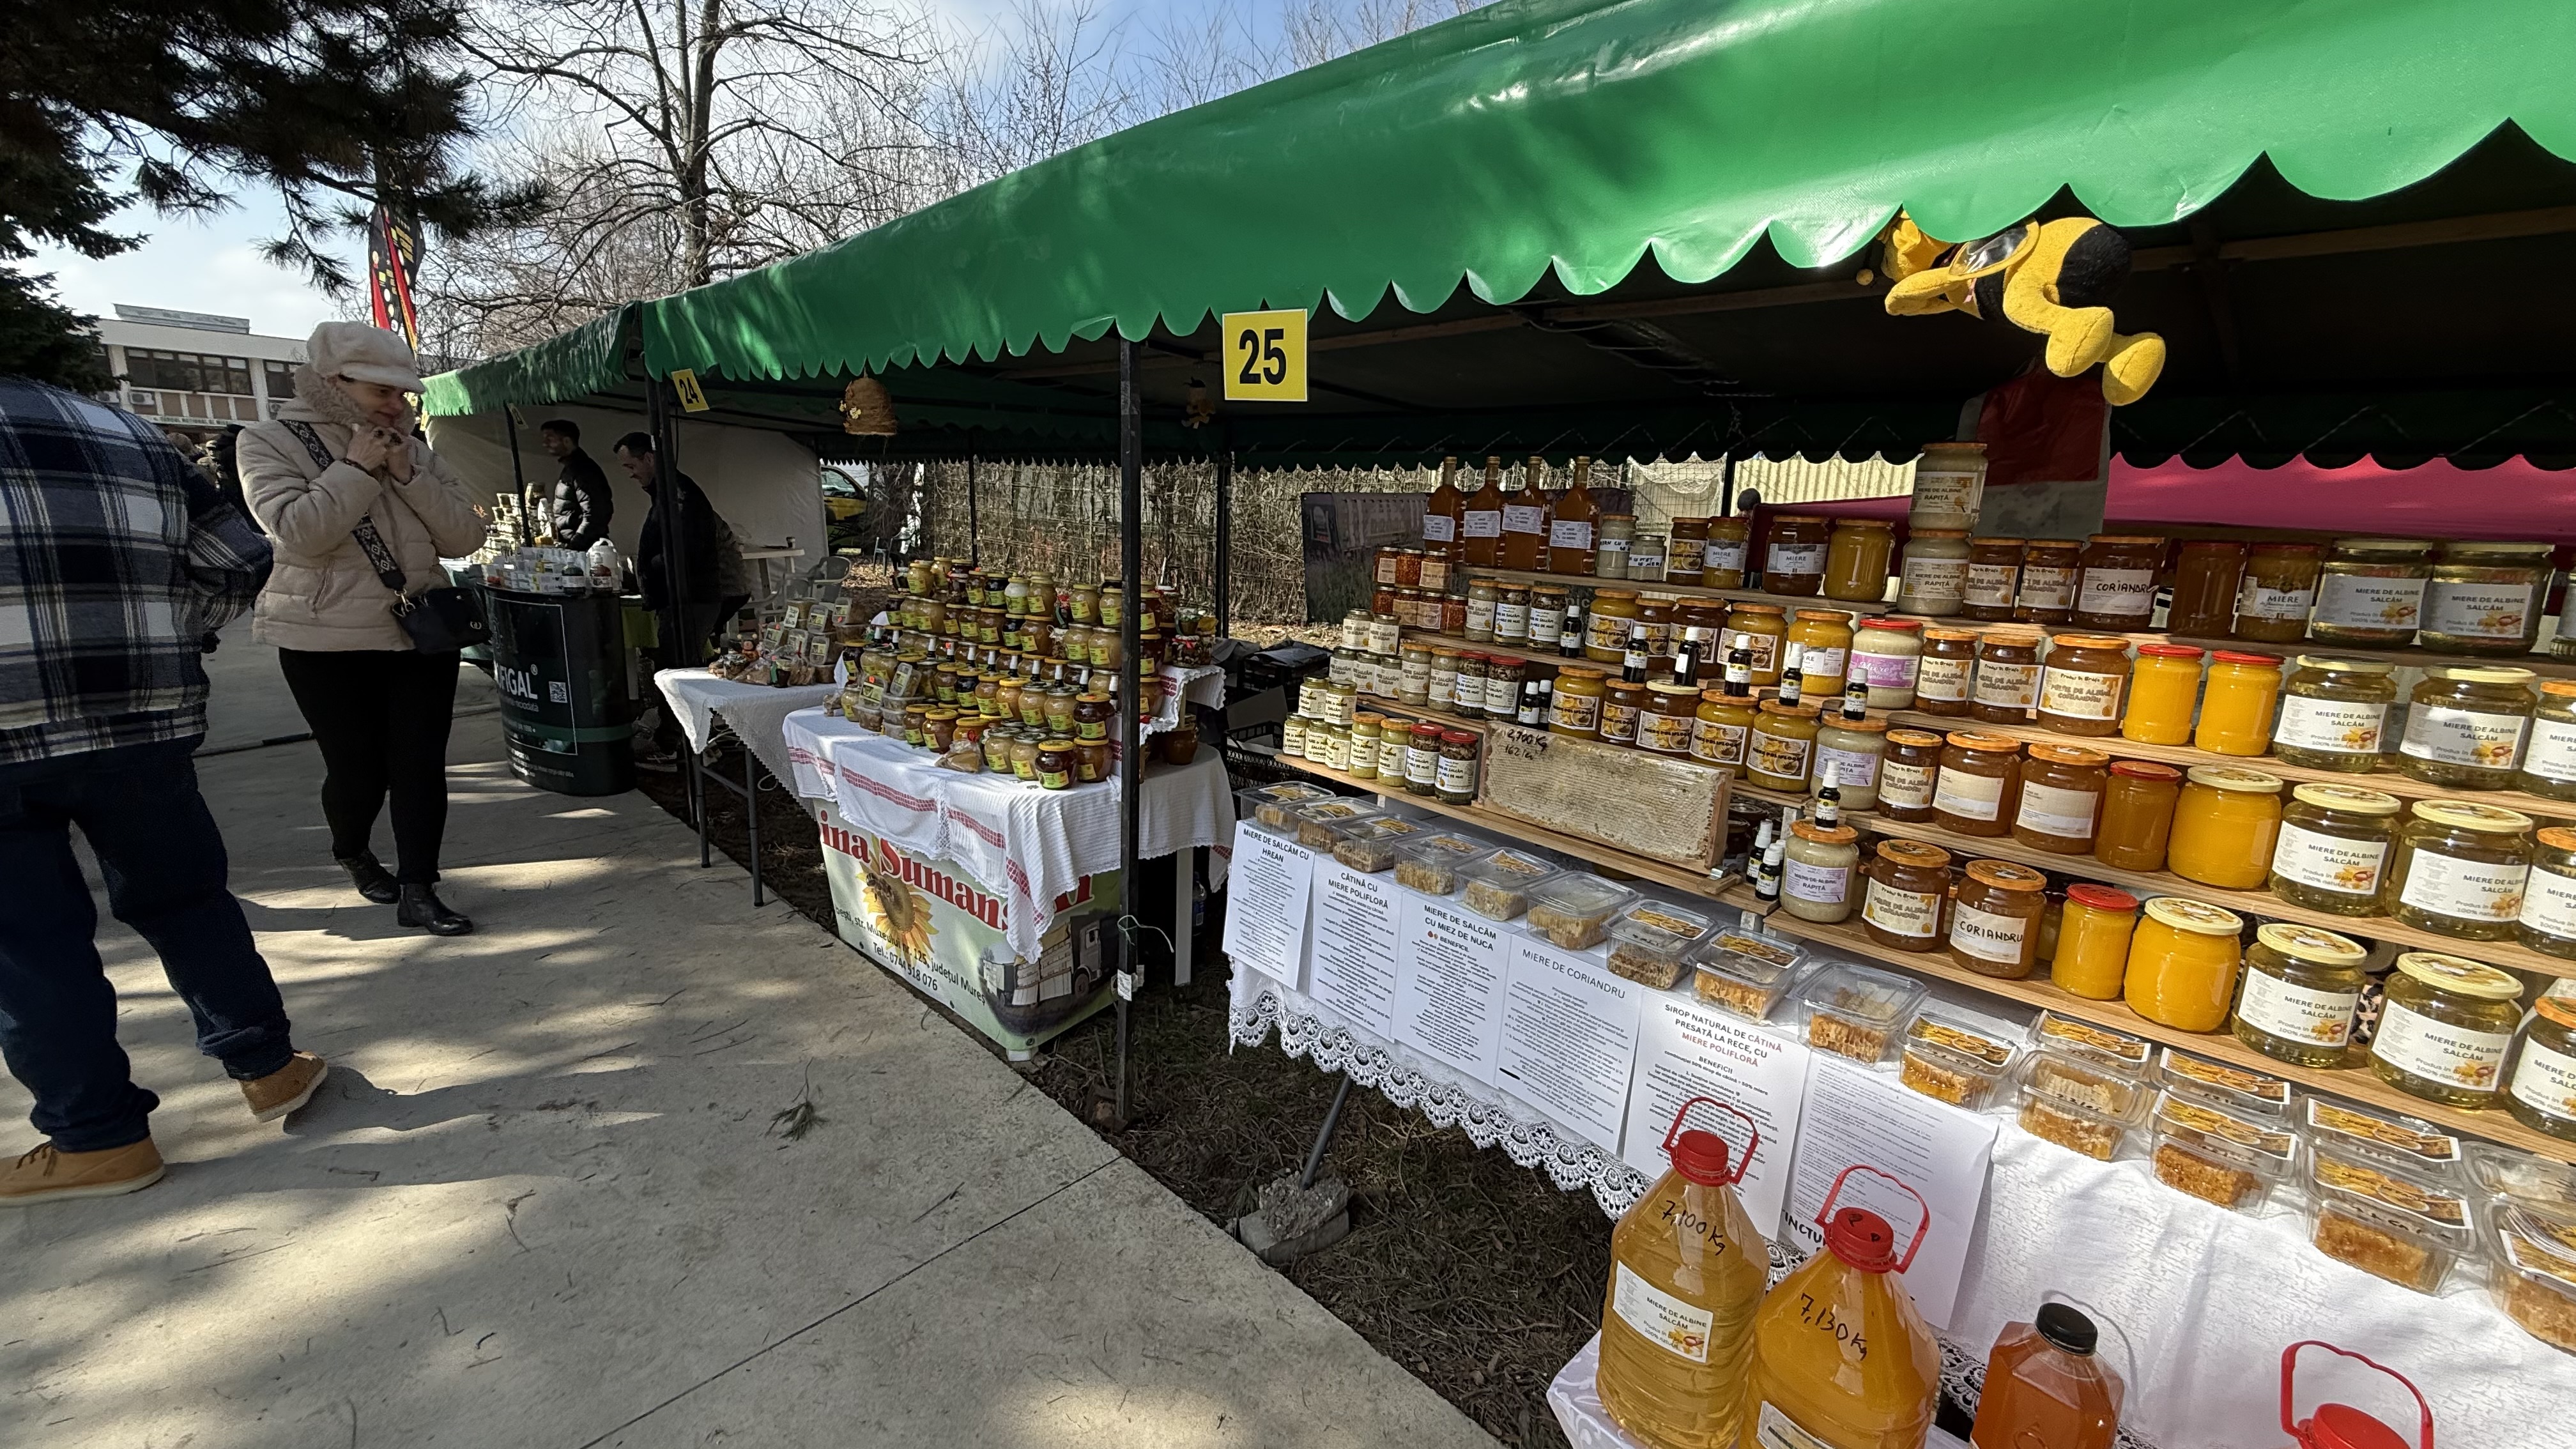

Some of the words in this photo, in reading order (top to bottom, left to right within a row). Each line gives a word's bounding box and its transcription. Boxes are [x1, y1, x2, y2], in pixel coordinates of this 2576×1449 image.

[1239, 328, 1287, 385] 25
[679, 377, 700, 404] 24
[2443, 721, 2471, 731] MIERE
[2436, 746, 2460, 755] Produs
[2542, 760, 2567, 768] Produs
[1244, 828, 1262, 843] MIERE
[1263, 835, 1271, 846] DE
[1300, 849, 1310, 860] CU
[2308, 844, 2334, 854] MIERE
[1262, 847, 1284, 862] HREAN
[2302, 868, 2324, 877] Produs
[2464, 875, 2493, 884] MIERE
[1328, 878, 1349, 895] MIERE
[1350, 887, 1388, 909] POLIFLORĂ
[1368, 882, 1377, 893] CU
[2455, 900, 2481, 909] Produs
[2457, 907, 2478, 916] 100%
[1424, 905, 1448, 921] MIERE
[1450, 914, 1460, 925] DE
[1462, 918, 1497, 940] SALCÂM
[2539, 914, 2564, 924] Produs
[2540, 921, 2561, 931] 100%
[1425, 917, 1436, 930] CU
[1438, 921, 1456, 936] MIEZ
[1458, 930, 1469, 942] DE
[1471, 935, 1494, 951] NUCA
[1960, 921, 2023, 942] CORIANDRU
[855, 916, 866, 930] str.
[867, 923, 901, 948] Muzeului
[914, 947, 930, 969] 125,
[873, 942, 889, 959] Tel.:
[889, 951, 907, 971] 0744
[907, 963, 921, 981] 518
[923, 975, 938, 991] 076
[1522, 949, 1551, 967] MIERE
[1552, 961, 1565, 974] DE
[1567, 967, 1626, 999] CORIANDRU
[2285, 995, 2313, 1008] MIERE
[1665, 1004, 1690, 1018] SIROP
[1692, 1011, 1732, 1034] NATURAL
[1734, 1029, 1746, 1039] DE
[1748, 1032, 1782, 1053] CĂTINĂ
[2278, 1020, 2301, 1030] Produs
[2278, 1027, 2298, 1036] 100%
[1675, 1018, 1712, 1039] PRESATĂ
[1714, 1033, 1725, 1044] LA
[1727, 1037, 1752, 1054] RECE,
[1754, 1047, 1767, 1059] CU
[2424, 1032, 2456, 1047] MIERE
[2459, 1042, 2472, 1050] DE
[2474, 1046, 2503, 1054] ALBINE
[1682, 1032, 1708, 1048] MIERE
[1710, 1042, 1758, 1068] POLIFLORĂ
[2442, 1047, 2483, 1061] SALCÂM
[1699, 1055, 1733, 1075] BENEFICII
[2416, 1057, 2442, 1070] Produs
[2416, 1065, 2438, 1077] 100%
[2534, 1059, 2566, 1076] MIERE
[2525, 1085, 2550, 1100] Produs
[2525, 1093, 2546, 1106] 100%
[1661, 1199, 1707, 1235] 7,100
[1707, 1225, 1726, 1257] Kg
[1782, 1209, 1827, 1246] INCTU
[1647, 1296, 1666, 1313] MIERE
[1680, 1315, 1706, 1328] ALBINE
[1643, 1320, 1660, 1334] Produs
[1659, 1313, 1688, 1330] SALCÂM
[1800, 1292, 1849, 1341] 7,130
[1850, 1333, 1867, 1361] Kg
[1644, 1328, 1659, 1339] 100%
